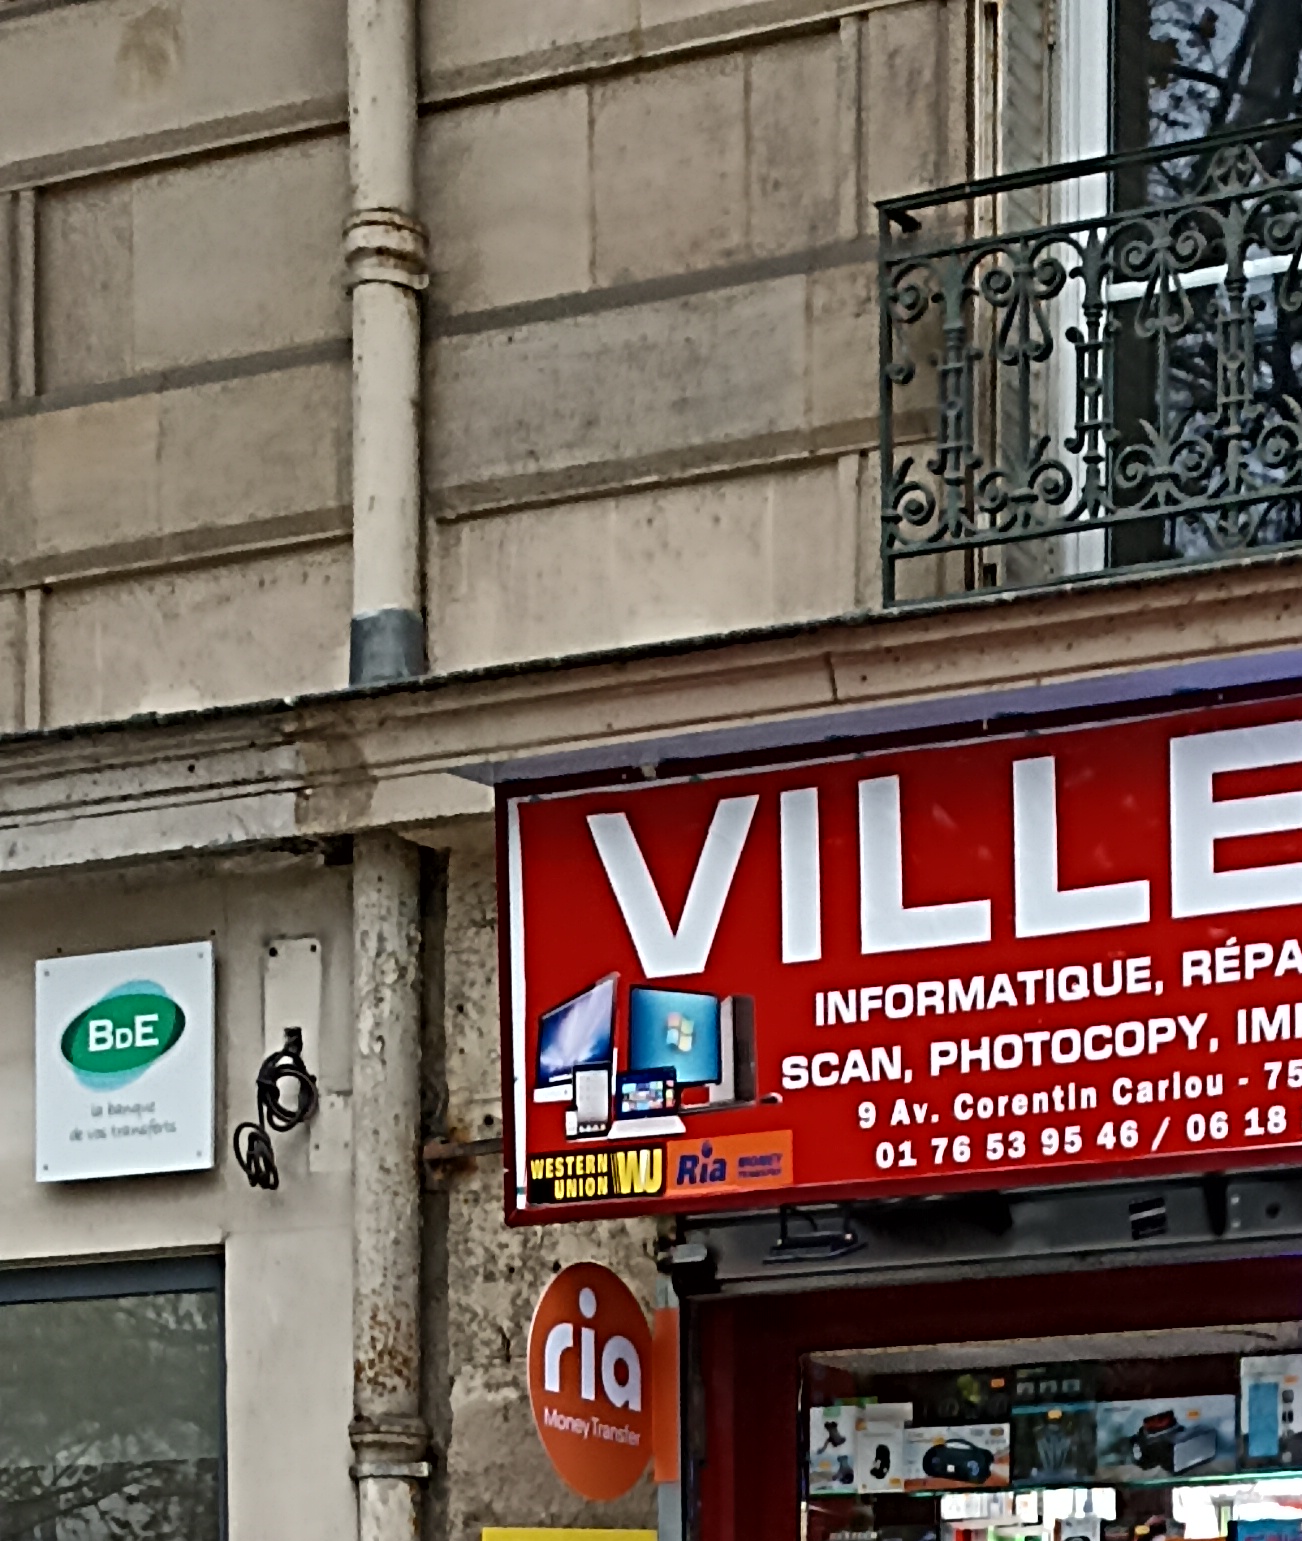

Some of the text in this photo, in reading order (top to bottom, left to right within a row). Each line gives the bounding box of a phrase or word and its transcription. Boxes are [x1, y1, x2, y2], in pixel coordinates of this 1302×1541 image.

[815, 956, 1164, 1026] INFORMATIQUE,
[782, 1046, 913, 1090] SCAN,
[930, 1013, 1220, 1076] PHOTOCOPY,
[858, 1101, 877, 1129] 9
[890, 1098, 940, 1126] Av.
[953, 1082, 1097, 1121] Corentin
[1112, 1071, 1225, 1107] Carlou
[676, 1140, 728, 1185] Ria
[875, 1140, 917, 1168] 01
[931, 1136, 971, 1164] 76
[986, 1131, 1026, 1159] 53
[1041, 1126, 1082, 1156] 95
[1097, 1120, 1138, 1150] 46
[1151, 1116, 1170, 1153] /
[1186, 1111, 1229, 1142] 06
[1244, 1105, 1287, 1136] 18
[530, 1153, 608, 1180] WESTERN
[554, 1175, 609, 1200] UNION
[544, 1287, 642, 1412] ria
[543, 1406, 642, 1447] Money Transfer
